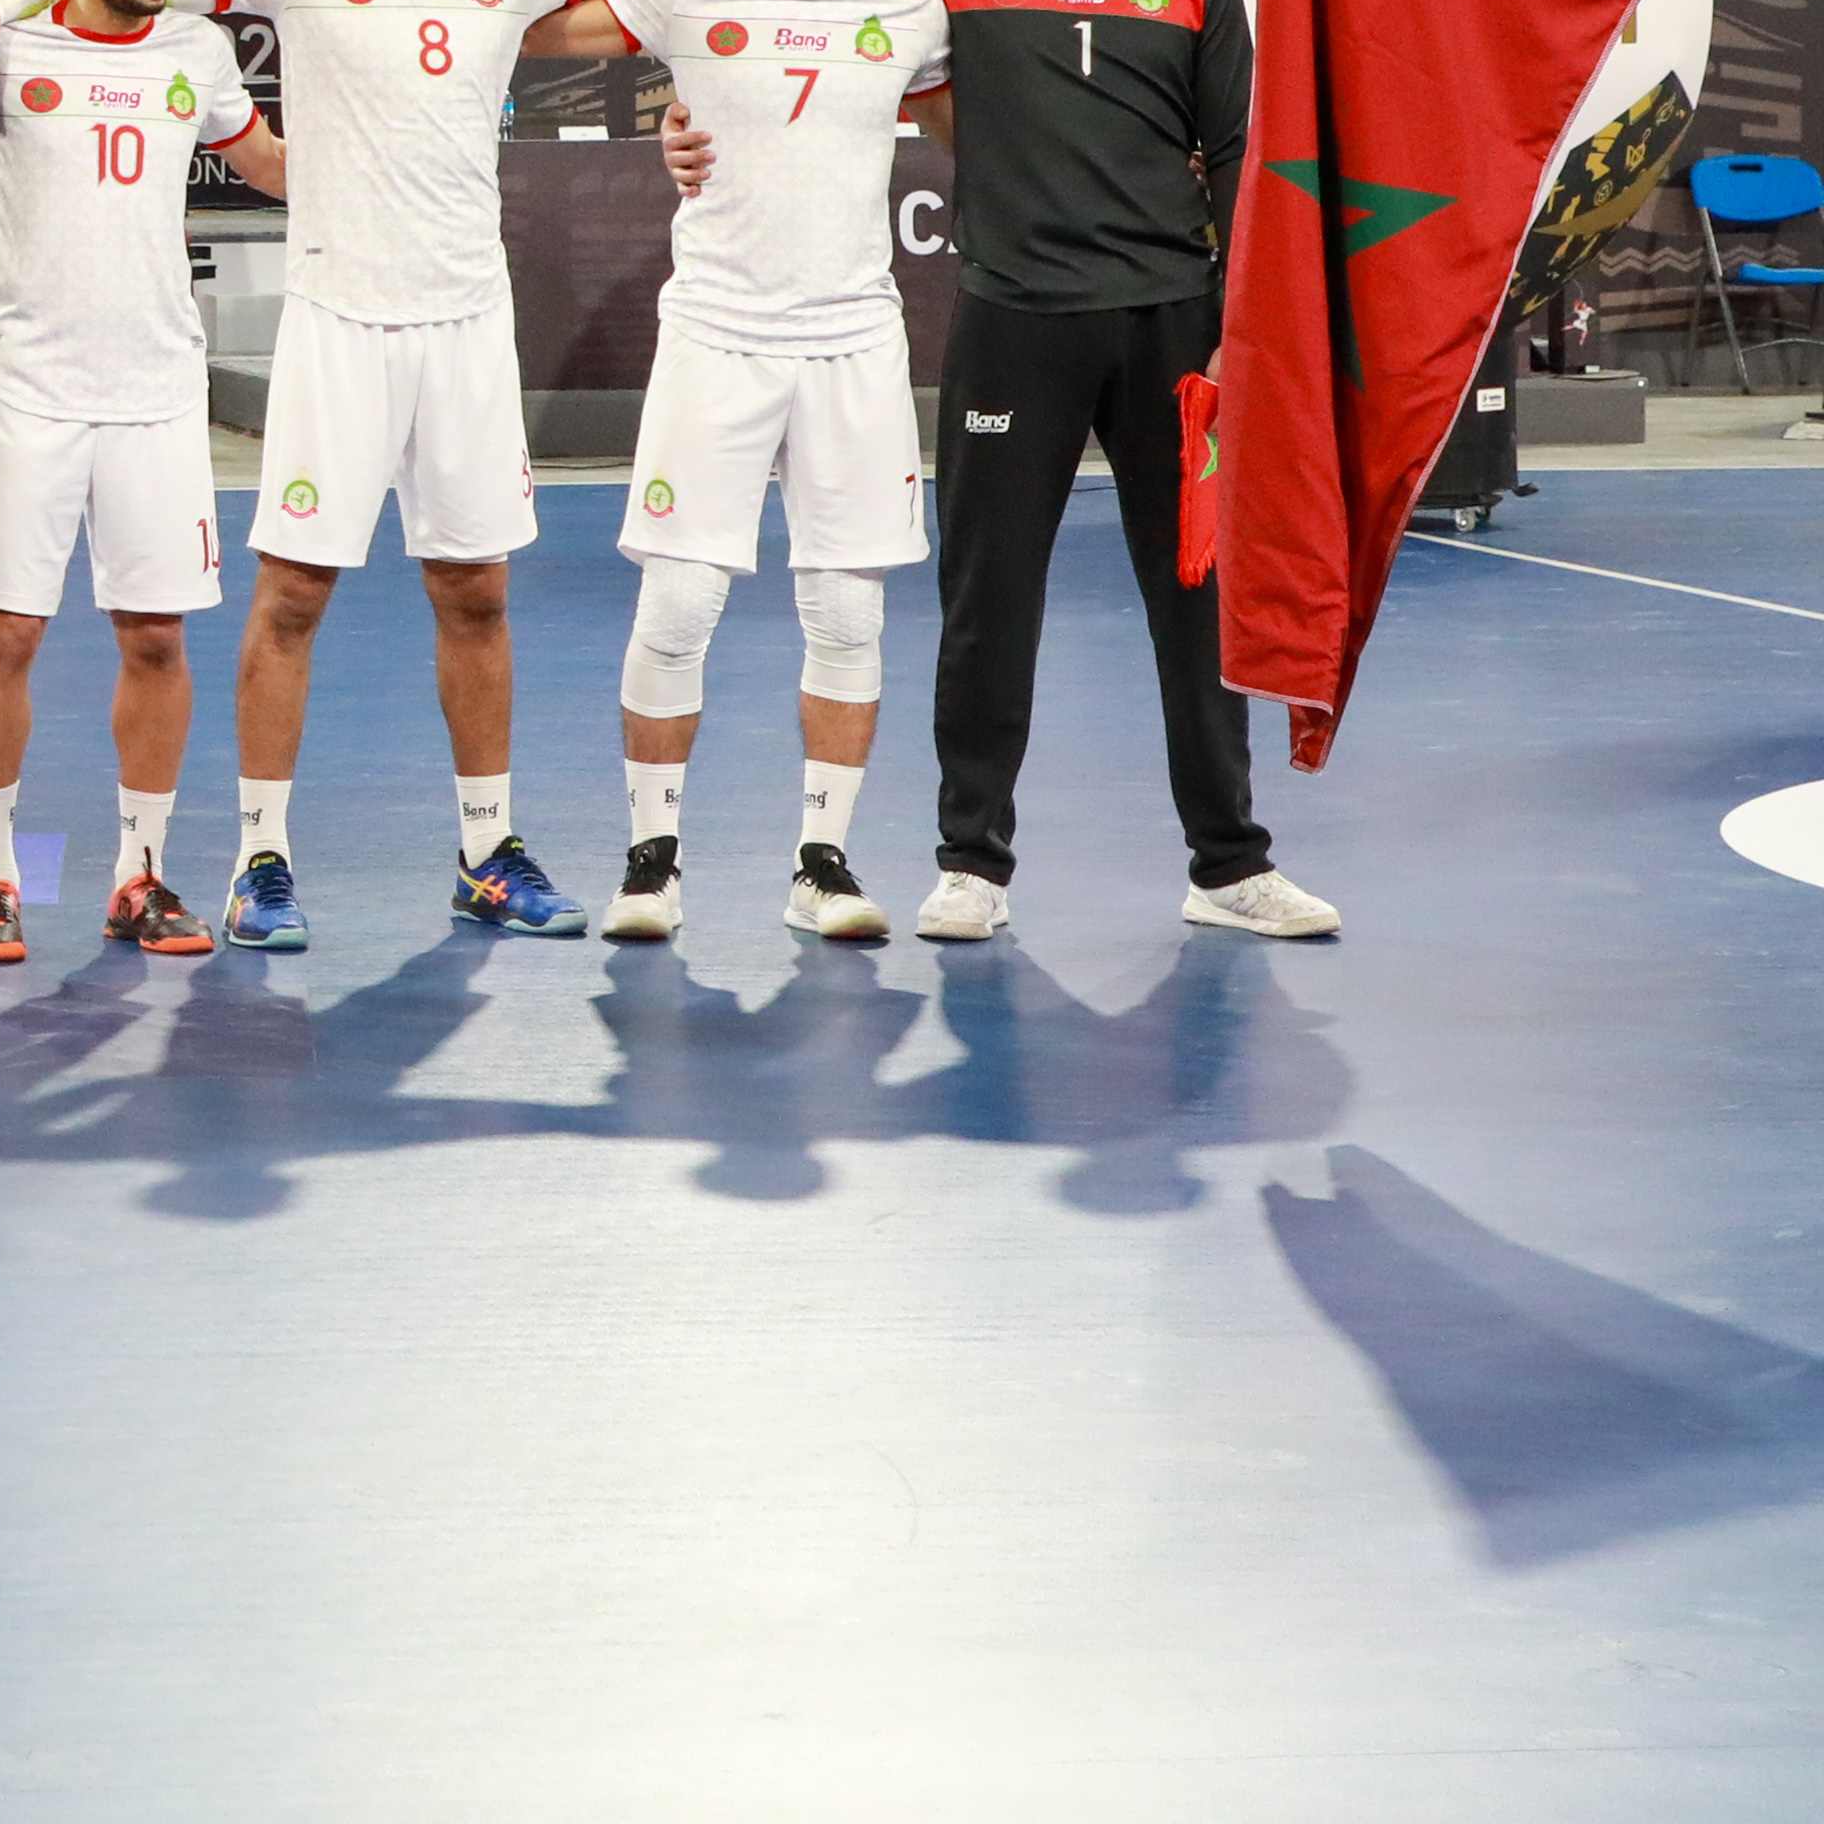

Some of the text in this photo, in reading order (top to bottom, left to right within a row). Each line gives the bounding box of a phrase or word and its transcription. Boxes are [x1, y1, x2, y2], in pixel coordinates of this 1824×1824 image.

[417, 18, 454, 77] 8
[774, 27, 827, 51] Bang
[1073, 20, 1092, 77] 1
[88, 84, 141, 109] Bang
[784, 67, 821, 124] 7
[90, 122, 146, 187] 10
